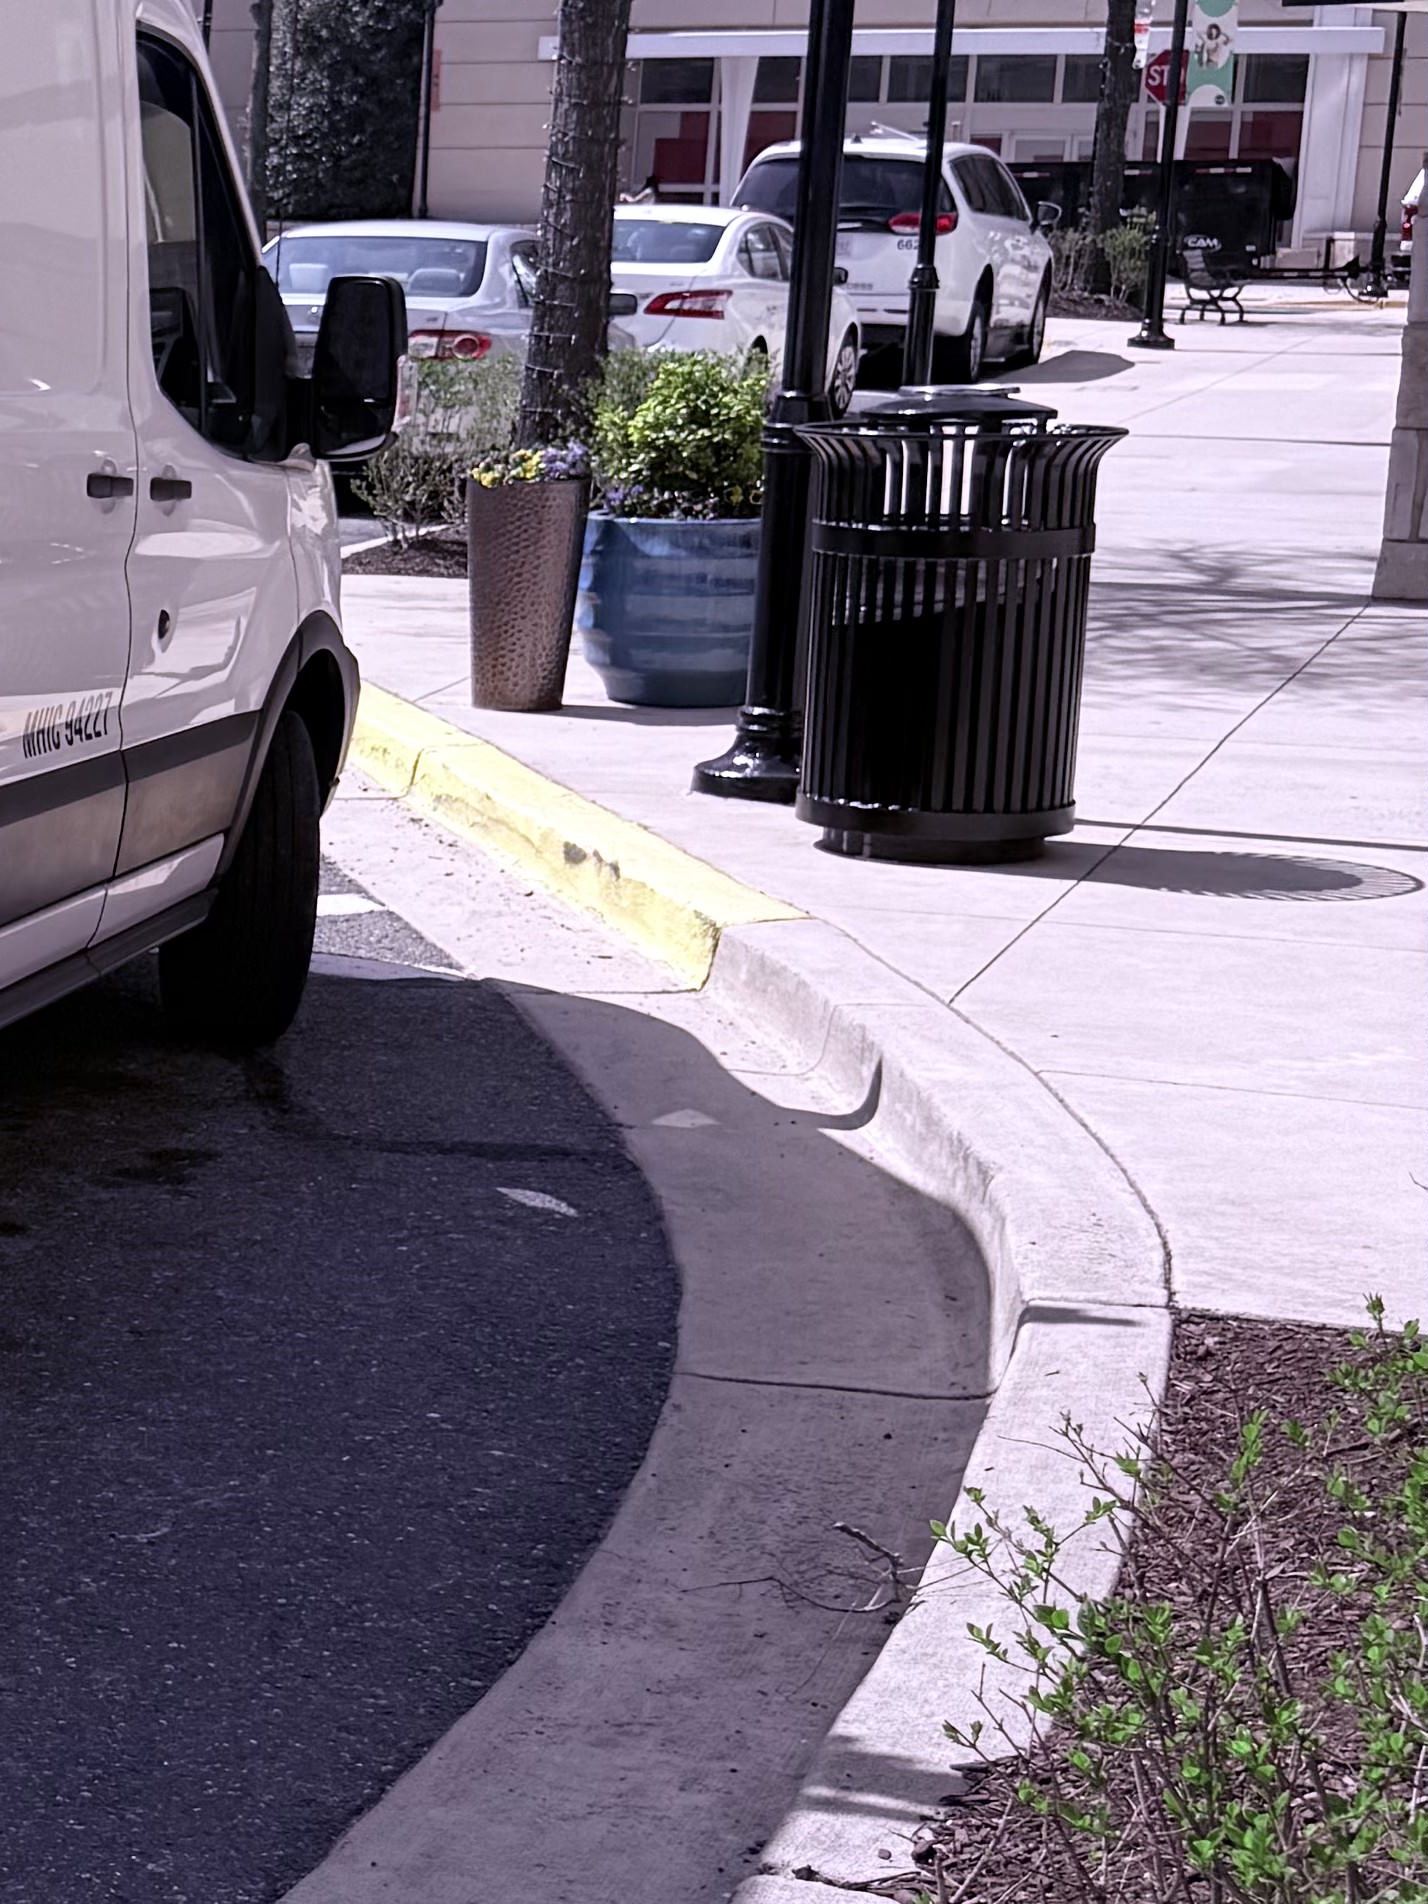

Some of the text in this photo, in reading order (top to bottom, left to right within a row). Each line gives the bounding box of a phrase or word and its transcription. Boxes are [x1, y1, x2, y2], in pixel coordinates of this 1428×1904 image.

[1147, 64, 1185, 86] ST
[22, 691, 114, 758] MHIC 94227
